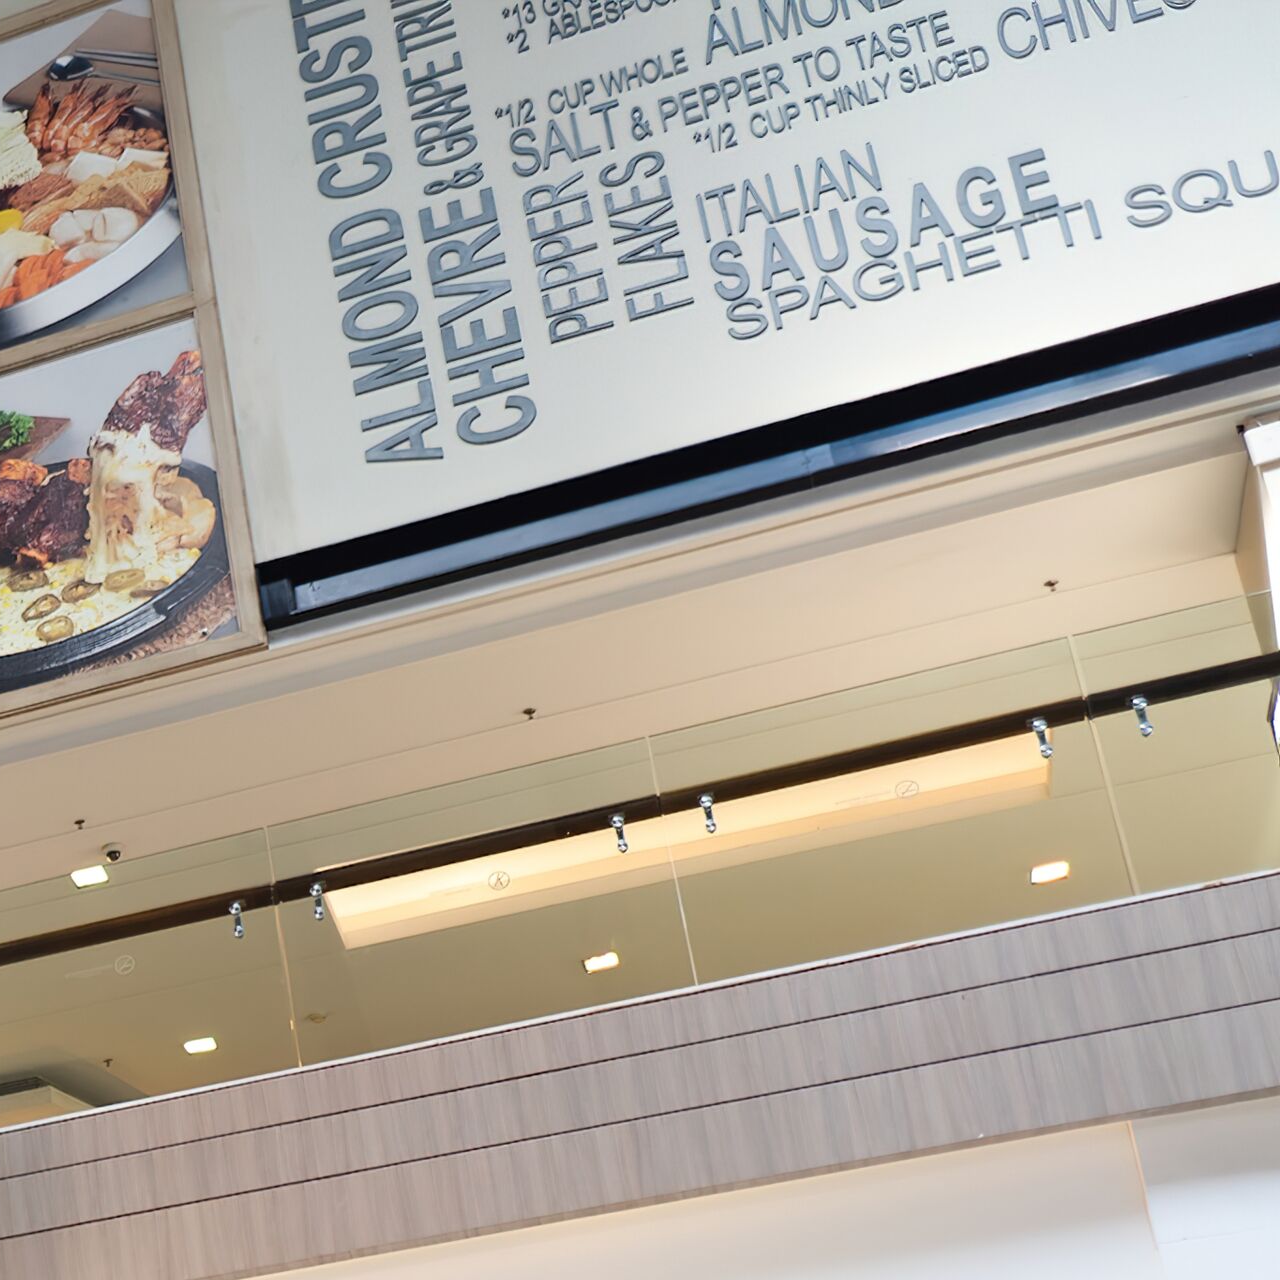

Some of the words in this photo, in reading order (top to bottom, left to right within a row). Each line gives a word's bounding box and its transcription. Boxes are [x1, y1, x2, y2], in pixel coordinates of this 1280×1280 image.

[402, 51, 478, 167] GRAPE
[509, 100, 619, 177] SALT
[630, 105, 652, 141] &
[658, 63, 790, 132] PEPPER
[792, 46, 841, 87] TO
[845, 11, 955, 70] TASTE
[548, 78, 595, 114] CUP
[600, 48, 688, 97] WHOLE
[749, 102, 800, 138] CUP
[805, 72, 891, 122] THINLY
[899, 46, 990, 94] SLICED
[423, 162, 484, 195] &
[523, 171, 614, 344] PEPPER
[599, 151, 695, 323] FLAKES
[696, 142, 883, 243] ITALIAN
[709, 147, 1060, 301] SAUSAGE
[726, 199, 1102, 340] SPAGHETTI
[1124, 149, 1280, 228] SQU
[328, 207, 444, 464] ALMOND
[419, 187, 537, 445] CHEVRE
